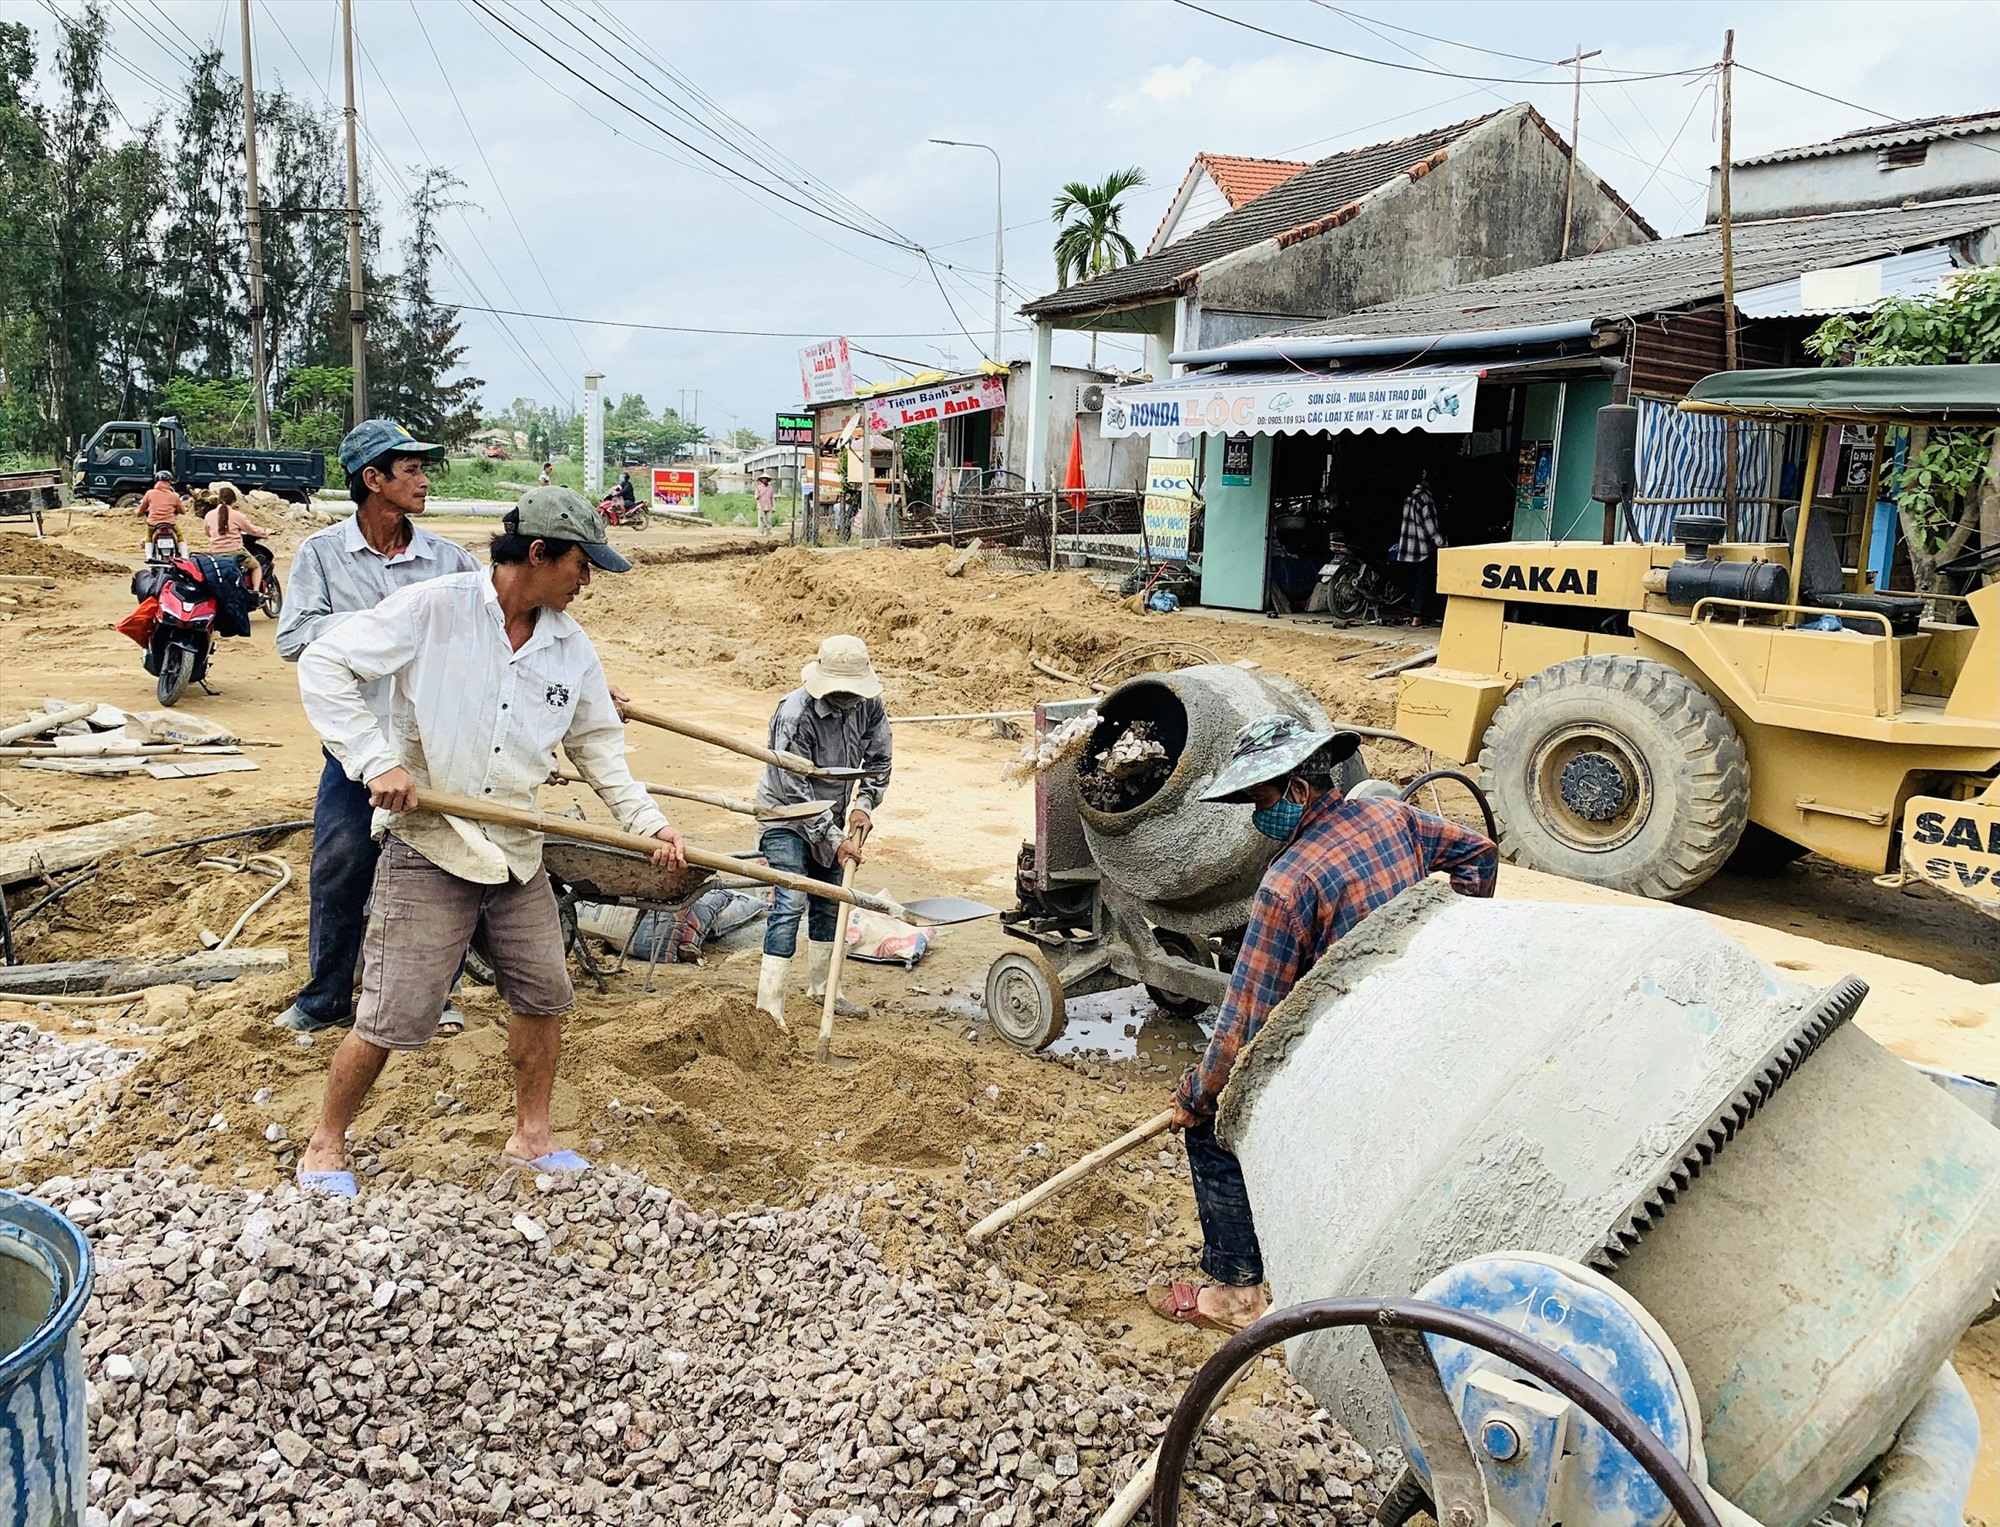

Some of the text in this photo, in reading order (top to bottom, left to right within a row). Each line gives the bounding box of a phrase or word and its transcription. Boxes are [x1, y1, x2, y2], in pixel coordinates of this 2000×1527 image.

[887, 389, 949, 409] Tiệm Bánh
[1307, 393, 1324, 405] SƠN
[1325, 389, 1341, 405] SỬA
[1348, 392, 1366, 403] MUA
[1368, 389, 1386, 402] BÁN
[1388, 389, 1409, 401] TRAO
[1411, 384, 1427, 401] ĐỔI
[901, 396, 981, 424] Lan Anh
[1130, 392, 1255, 432] HONDA LỘC
[1307, 409, 1323, 423] CÁC
[1324, 411, 1342, 425] LOẠI
[1343, 410, 1354, 422] XE
[1382, 409, 1393, 421] XE
[1395, 408, 1409, 420] TAY
[1411, 408, 1423, 420] GA
[779, 429, 795, 441] LAN
[217, 462, 234, 471] 92K
[245, 463, 257, 472] 74
[269, 463, 281, 472] 76
[1150, 463, 1192, 477] HONDA
[1152, 476, 1187, 491] LỘC
[1481, 564, 1598, 595] SAKAI
[1513, 1286, 1570, 1332] 10
